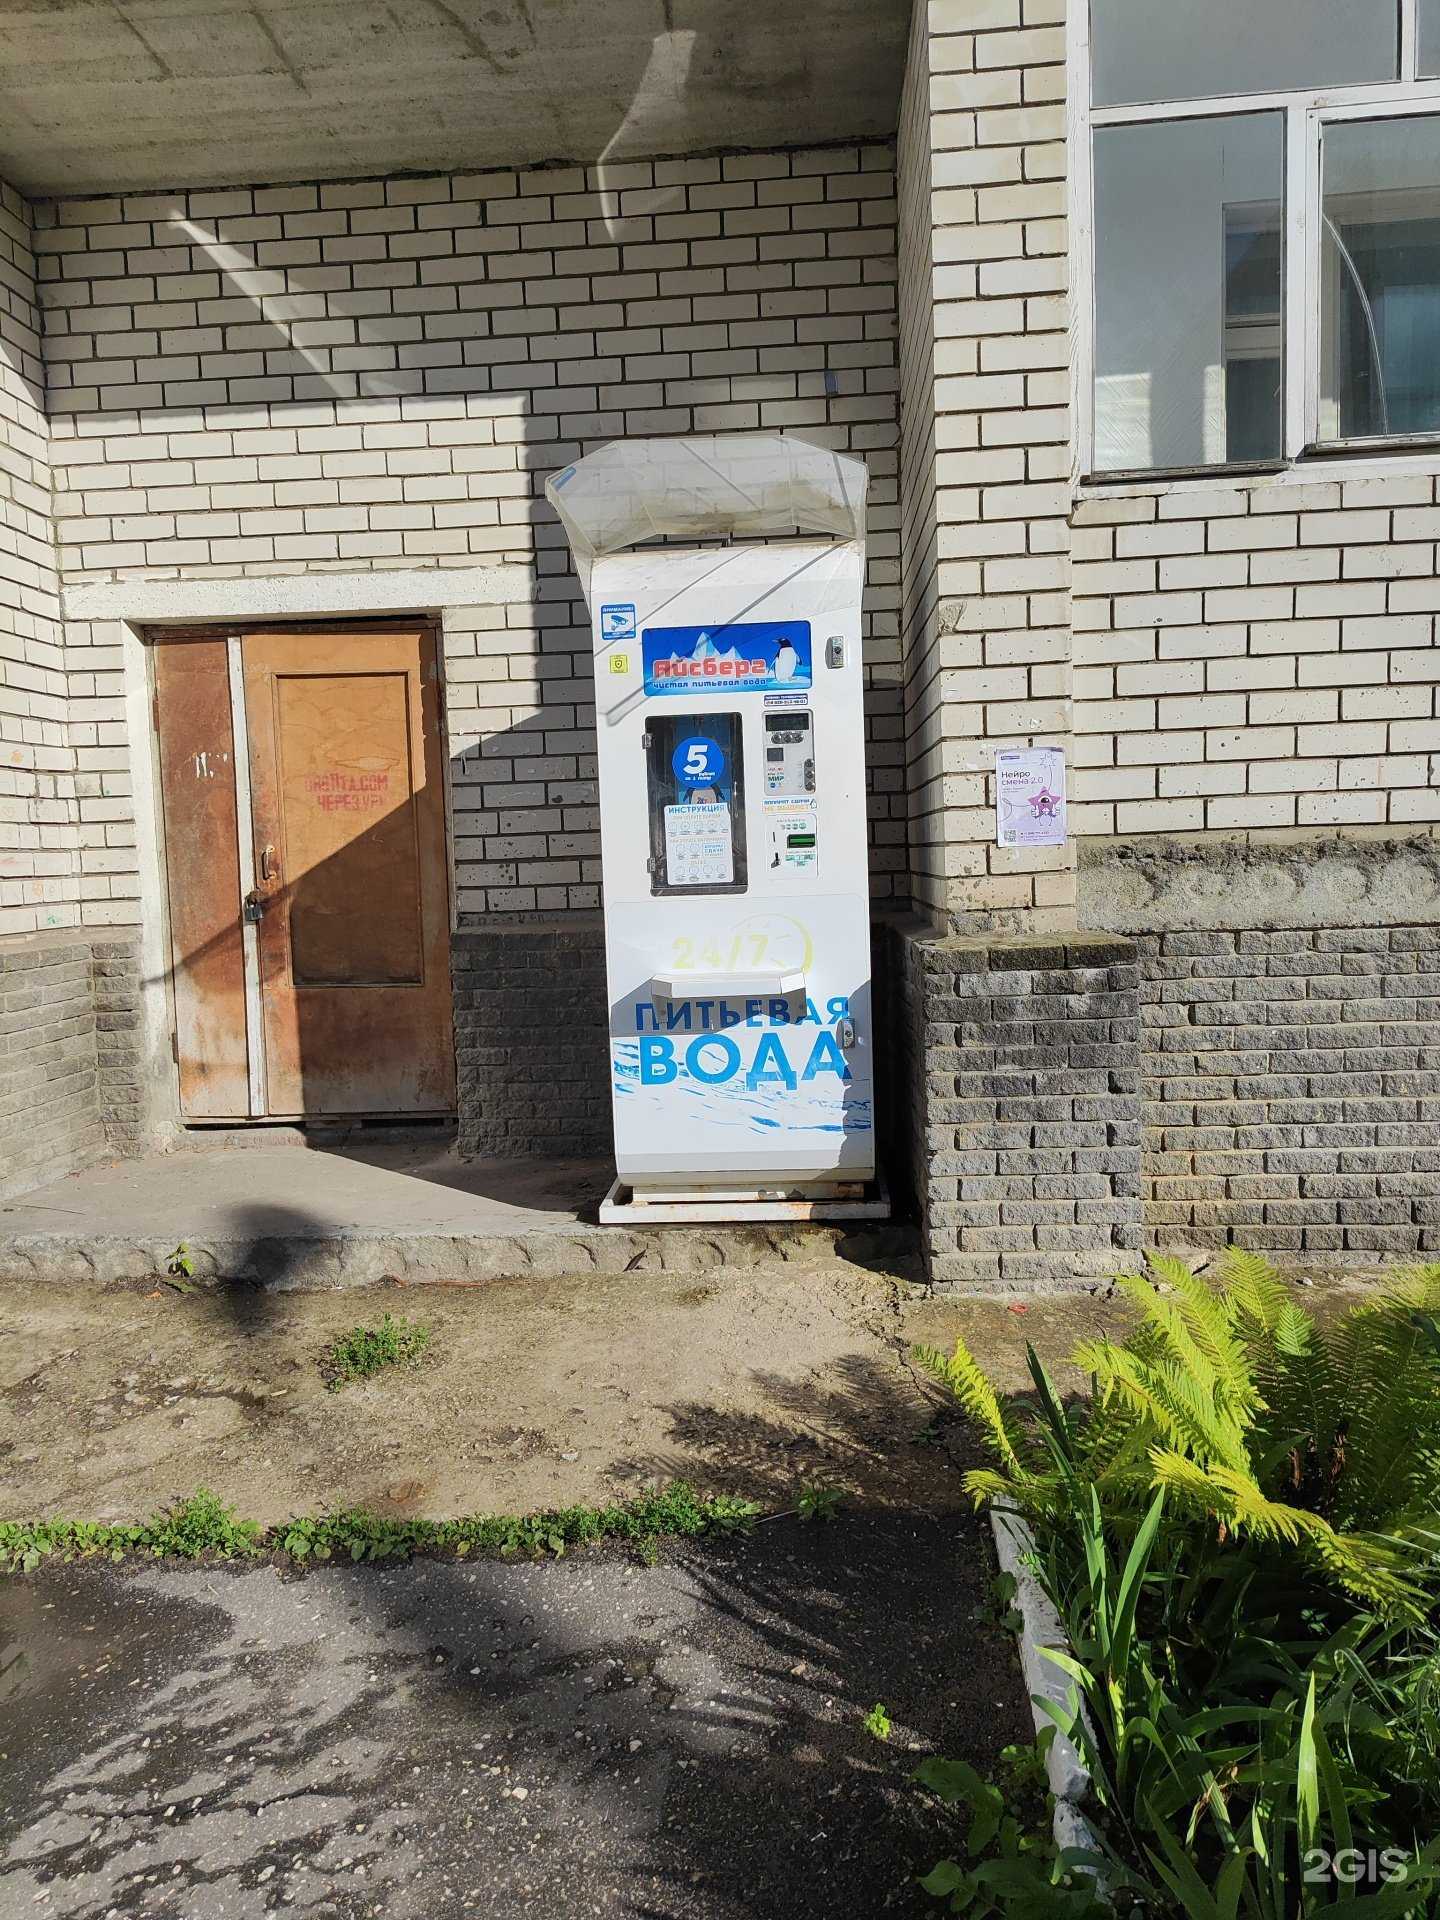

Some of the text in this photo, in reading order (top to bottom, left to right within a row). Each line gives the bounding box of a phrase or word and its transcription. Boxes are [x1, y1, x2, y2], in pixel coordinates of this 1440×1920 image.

[654, 657, 766, 679] Айсберг
[653, 678, 766, 689] чистая питьевая вода
[682, 744, 709, 775] 5
[1001, 770, 1031, 779] Нейро
[1030, 777, 1044, 785] 2.0
[668, 803, 725, 814] ИНСТРУКЦИЯ
[672, 933, 771, 969] 24/7
[635, 996, 850, 1031] ПИТЬЕВАЯ
[640, 1030, 853, 1092] ВОДА
